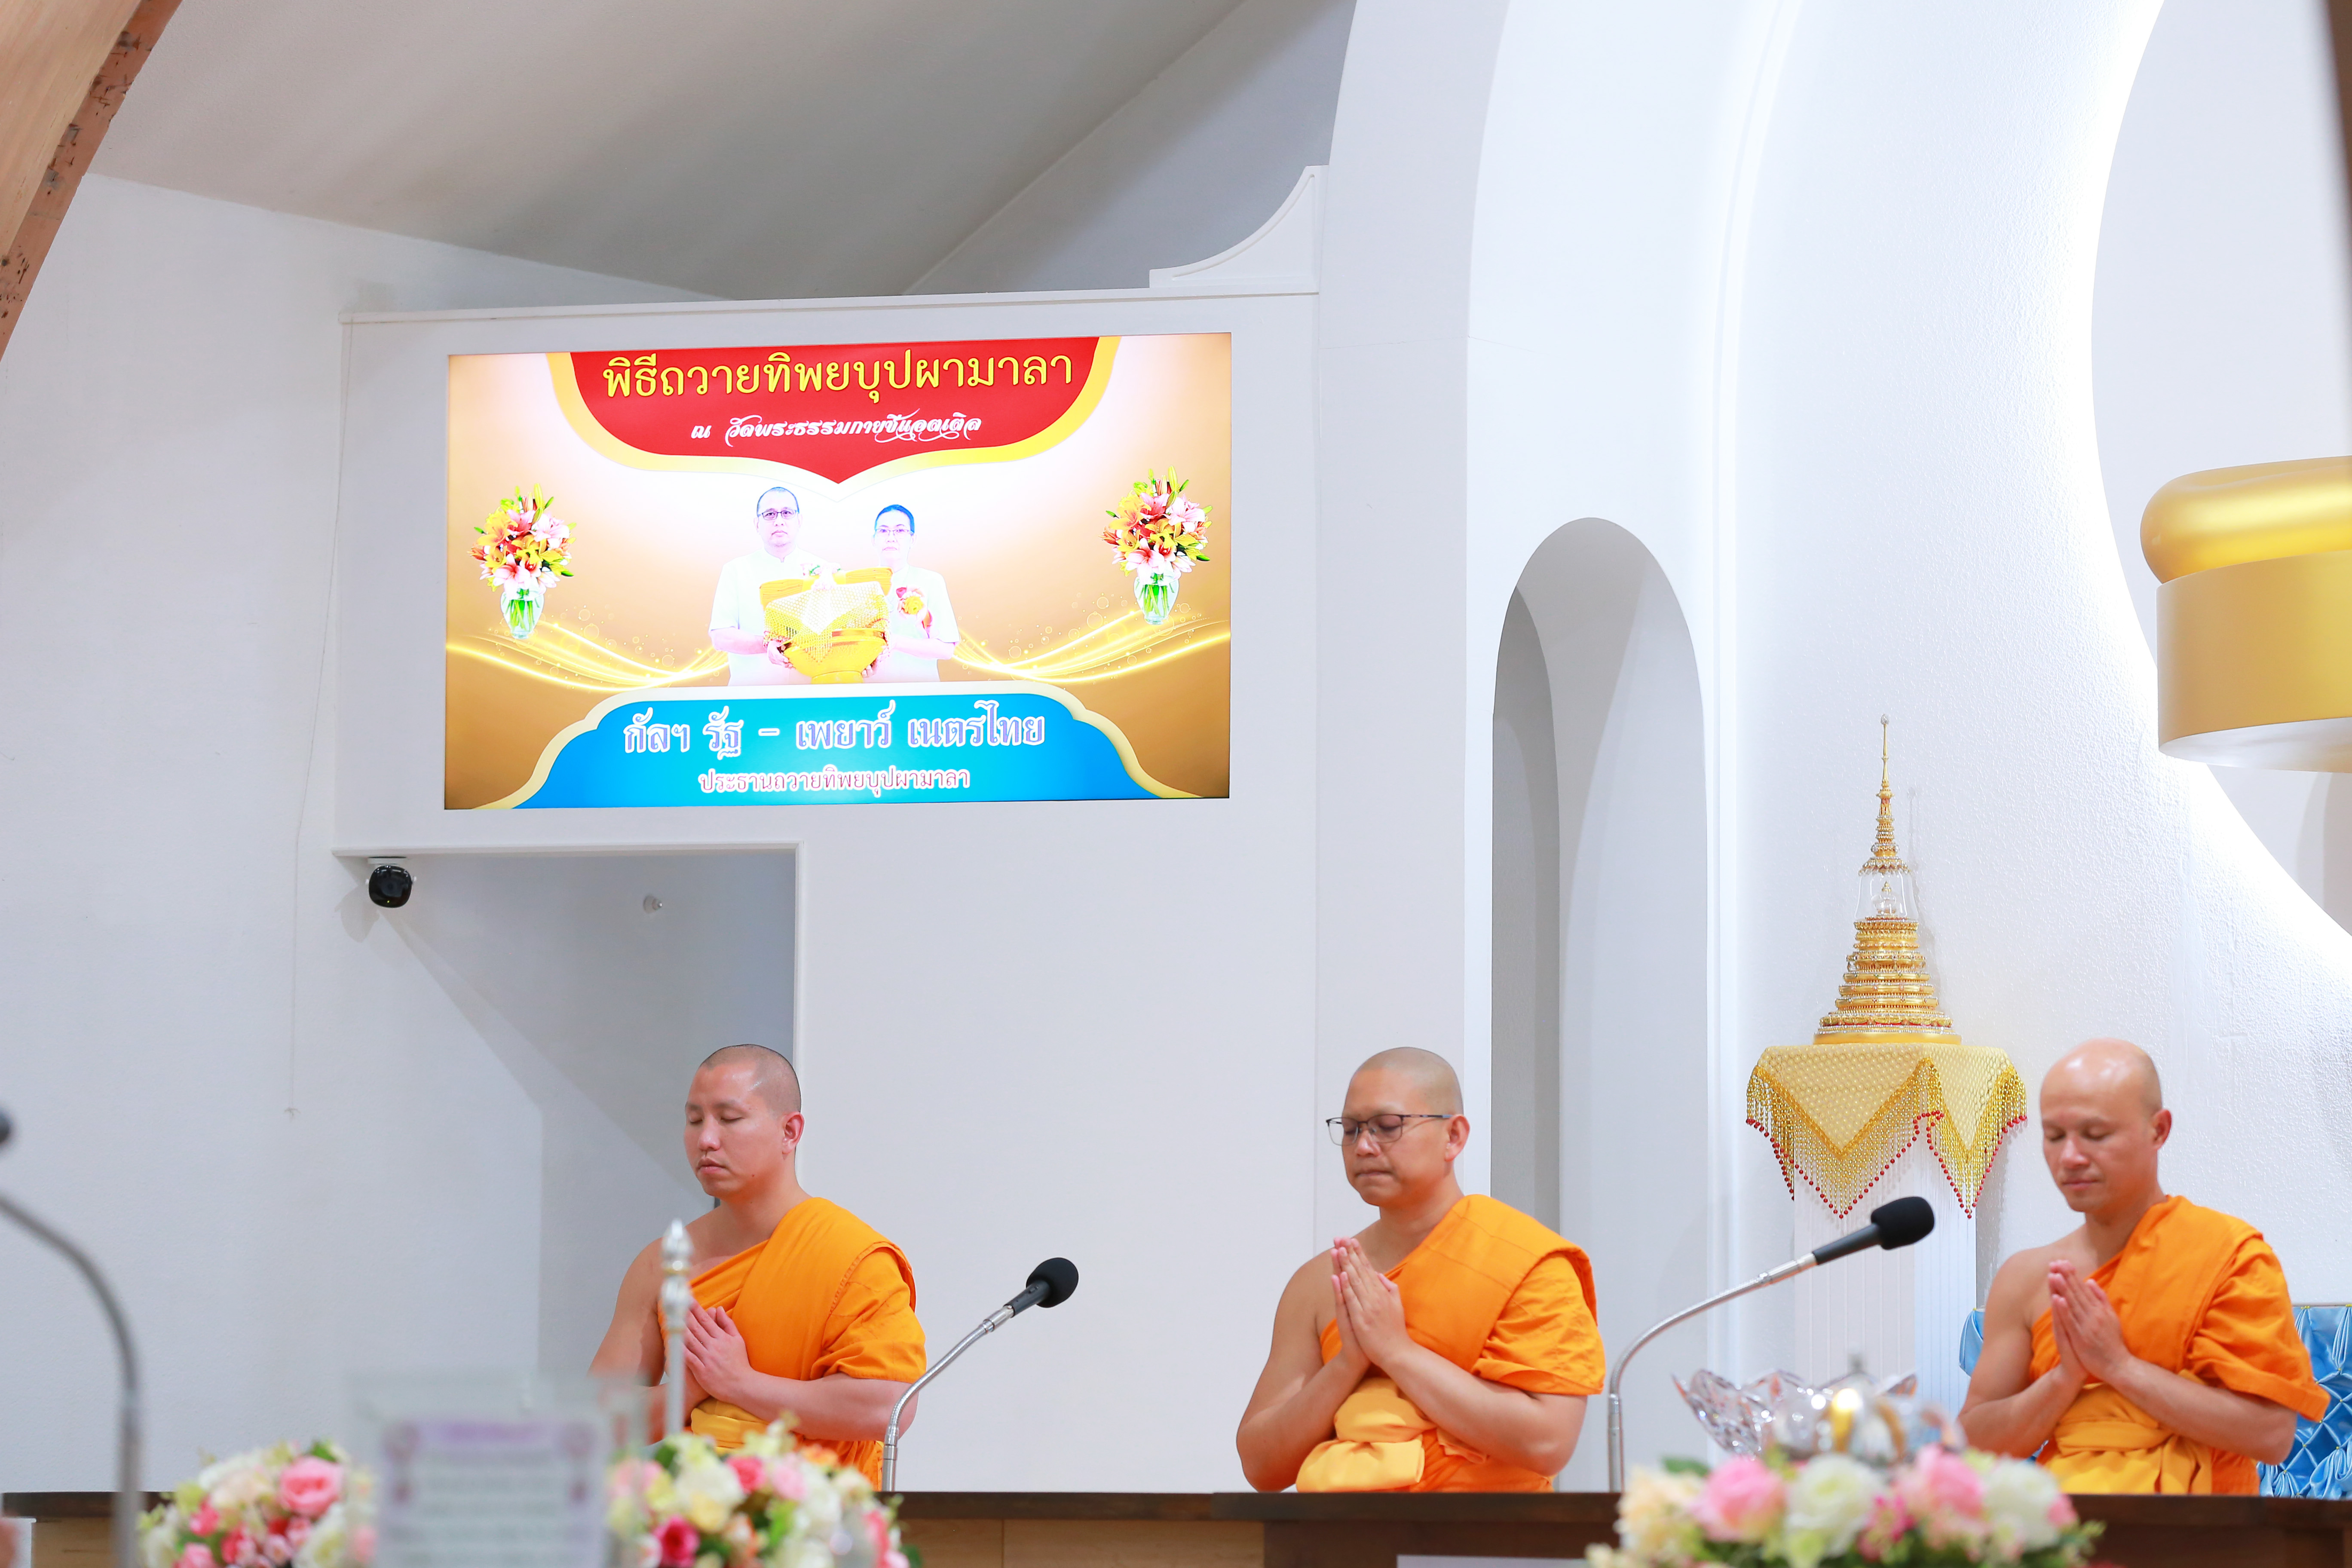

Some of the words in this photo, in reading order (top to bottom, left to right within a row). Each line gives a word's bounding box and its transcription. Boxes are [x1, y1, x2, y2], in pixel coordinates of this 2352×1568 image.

[603, 349, 1072, 404] พิธีถวายทิพยบุปผามาลา
[691, 425, 711, 438] ณ
[623, 707, 690, 753] กัลฯ
[702, 706, 744, 760] รัฐ
[796, 700, 895, 750] เพยาว์
[908, 700, 1045, 747] เนตรไทย
[698, 764, 970, 798] ประธานถวายทิพยบุปผามาลา
